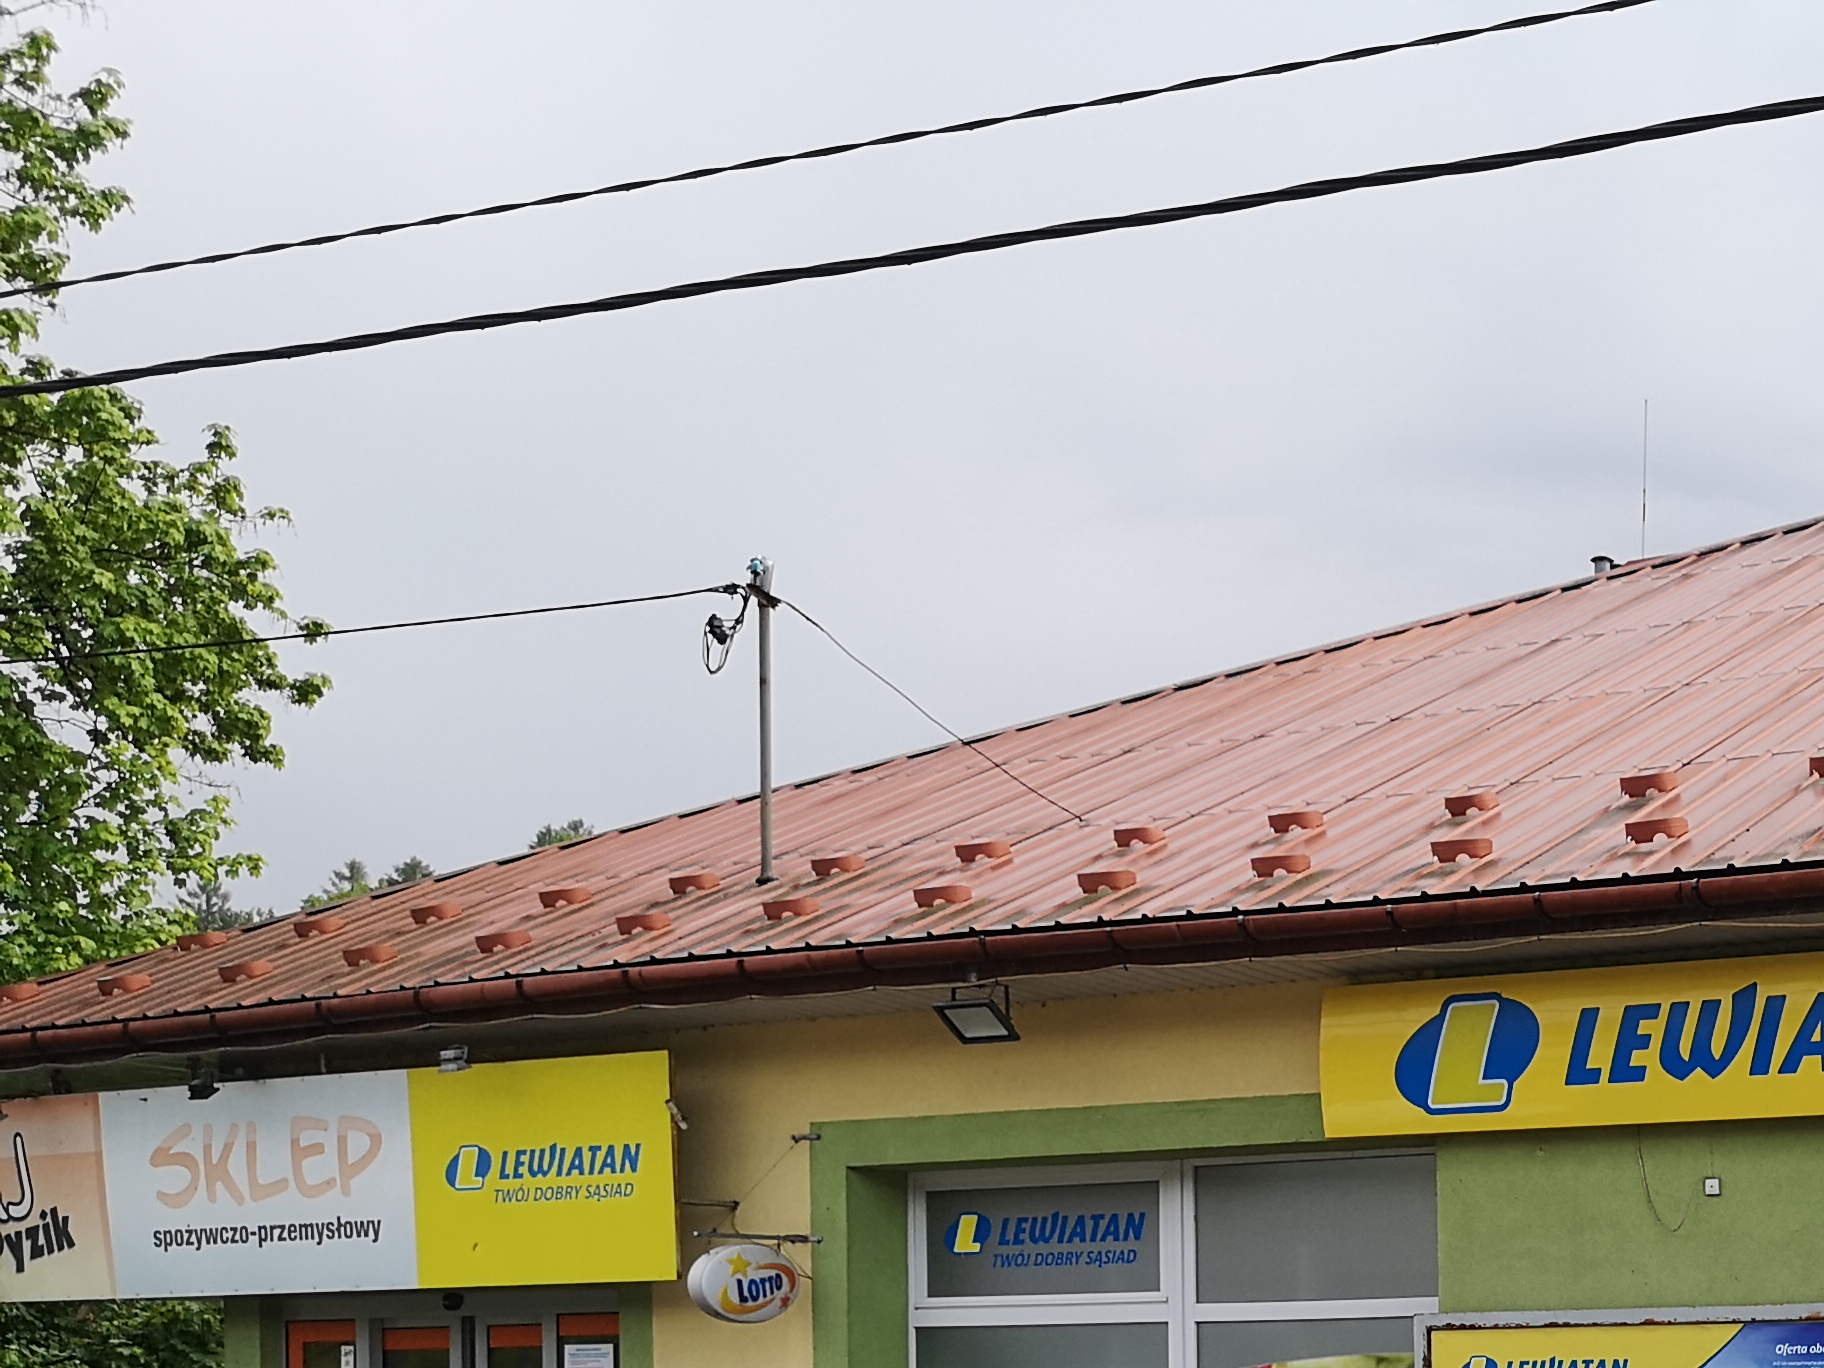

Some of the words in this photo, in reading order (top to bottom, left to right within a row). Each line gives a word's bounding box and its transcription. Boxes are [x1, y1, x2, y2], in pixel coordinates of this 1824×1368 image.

[149, 1115, 383, 1209] SKLEP
[499, 1142, 642, 1180] LEWIATAN
[494, 1183, 530, 1203] TWÓJ
[533, 1185, 583, 1202] DOBRY
[585, 1182, 634, 1202] SĄSIAD
[153, 1216, 382, 1252] spożywczo-przemysłowy
[998, 1211, 1146, 1246] LEWIATAN
[992, 1249, 1031, 1268] TWÓJ
[1034, 1251, 1084, 1267] DOBRY
[1085, 1248, 1138, 1268] SĄSIAD
[1775, 1342, 1808, 1356] Oferta
